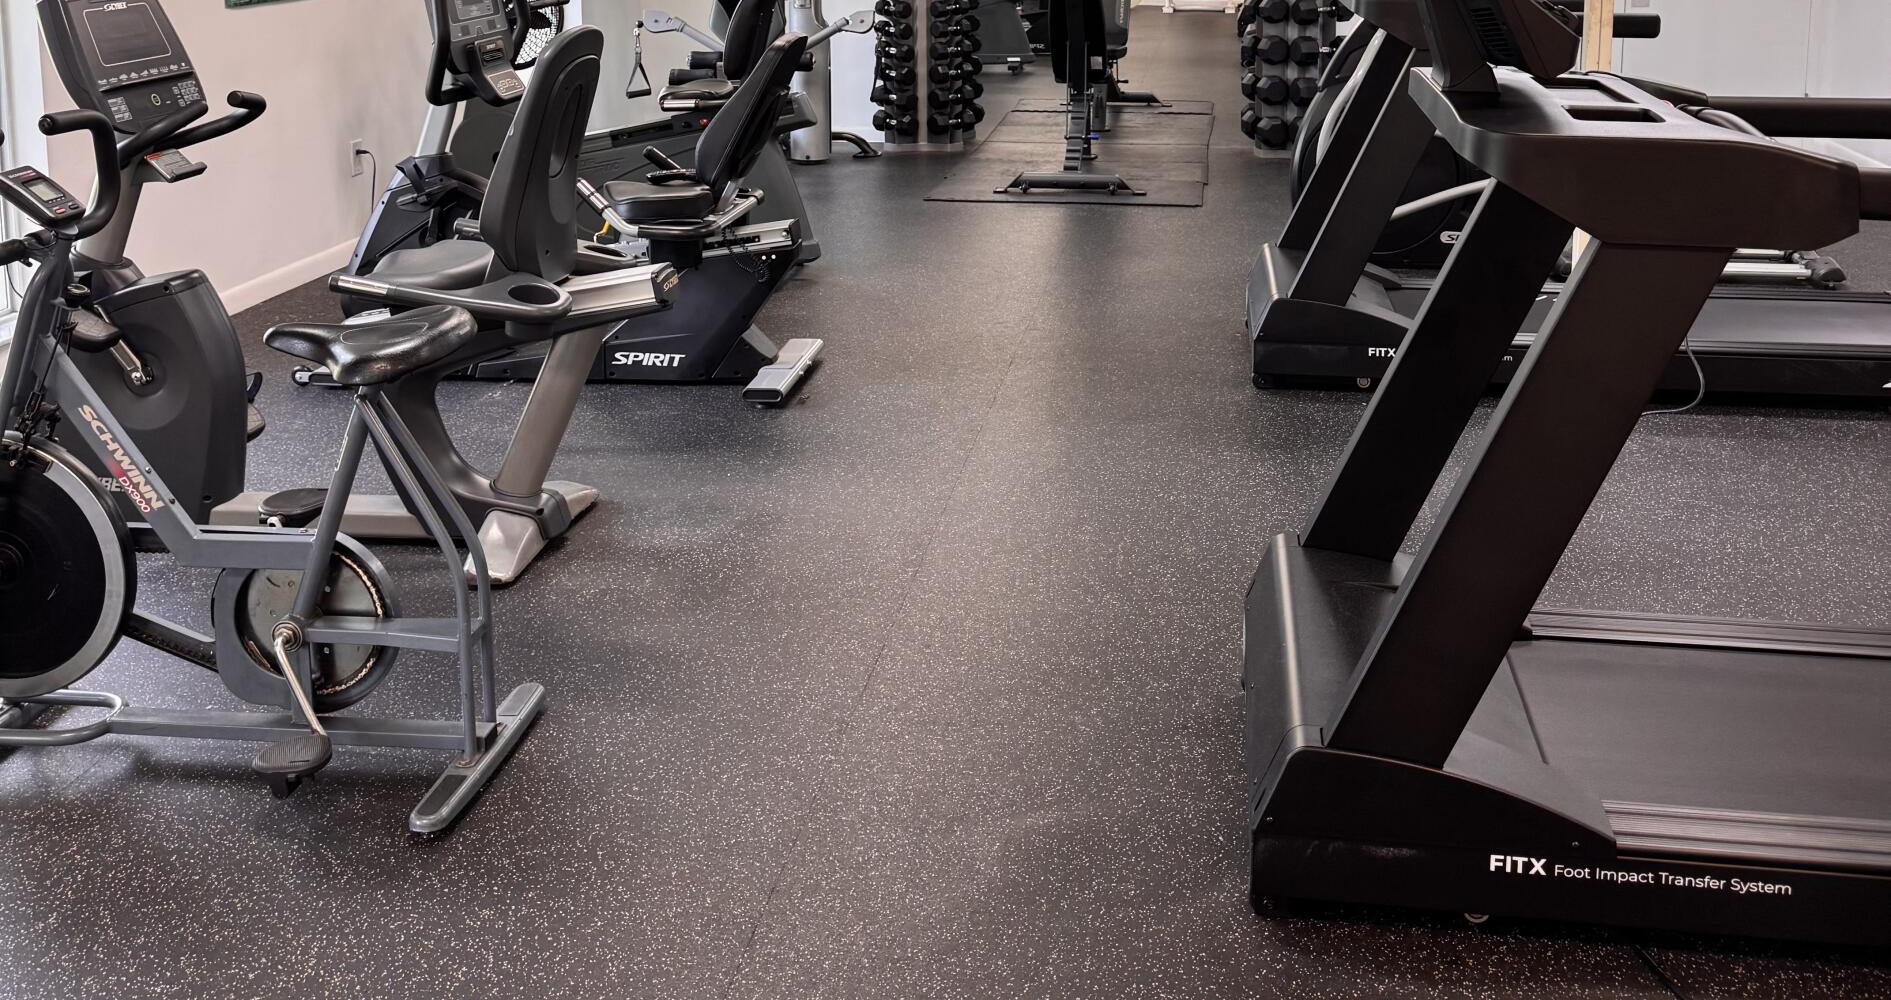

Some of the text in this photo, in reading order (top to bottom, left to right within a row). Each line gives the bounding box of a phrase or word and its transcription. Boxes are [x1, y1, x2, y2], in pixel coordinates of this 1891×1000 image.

[611, 351, 686, 368] SPIRIT
[1368, 347, 1396, 357] FITX
[77, 404, 166, 511] SCHWINN
[118, 476, 151, 513] DX900
[1489, 854, 1792, 896] FITX Foot Impact Transfer System
